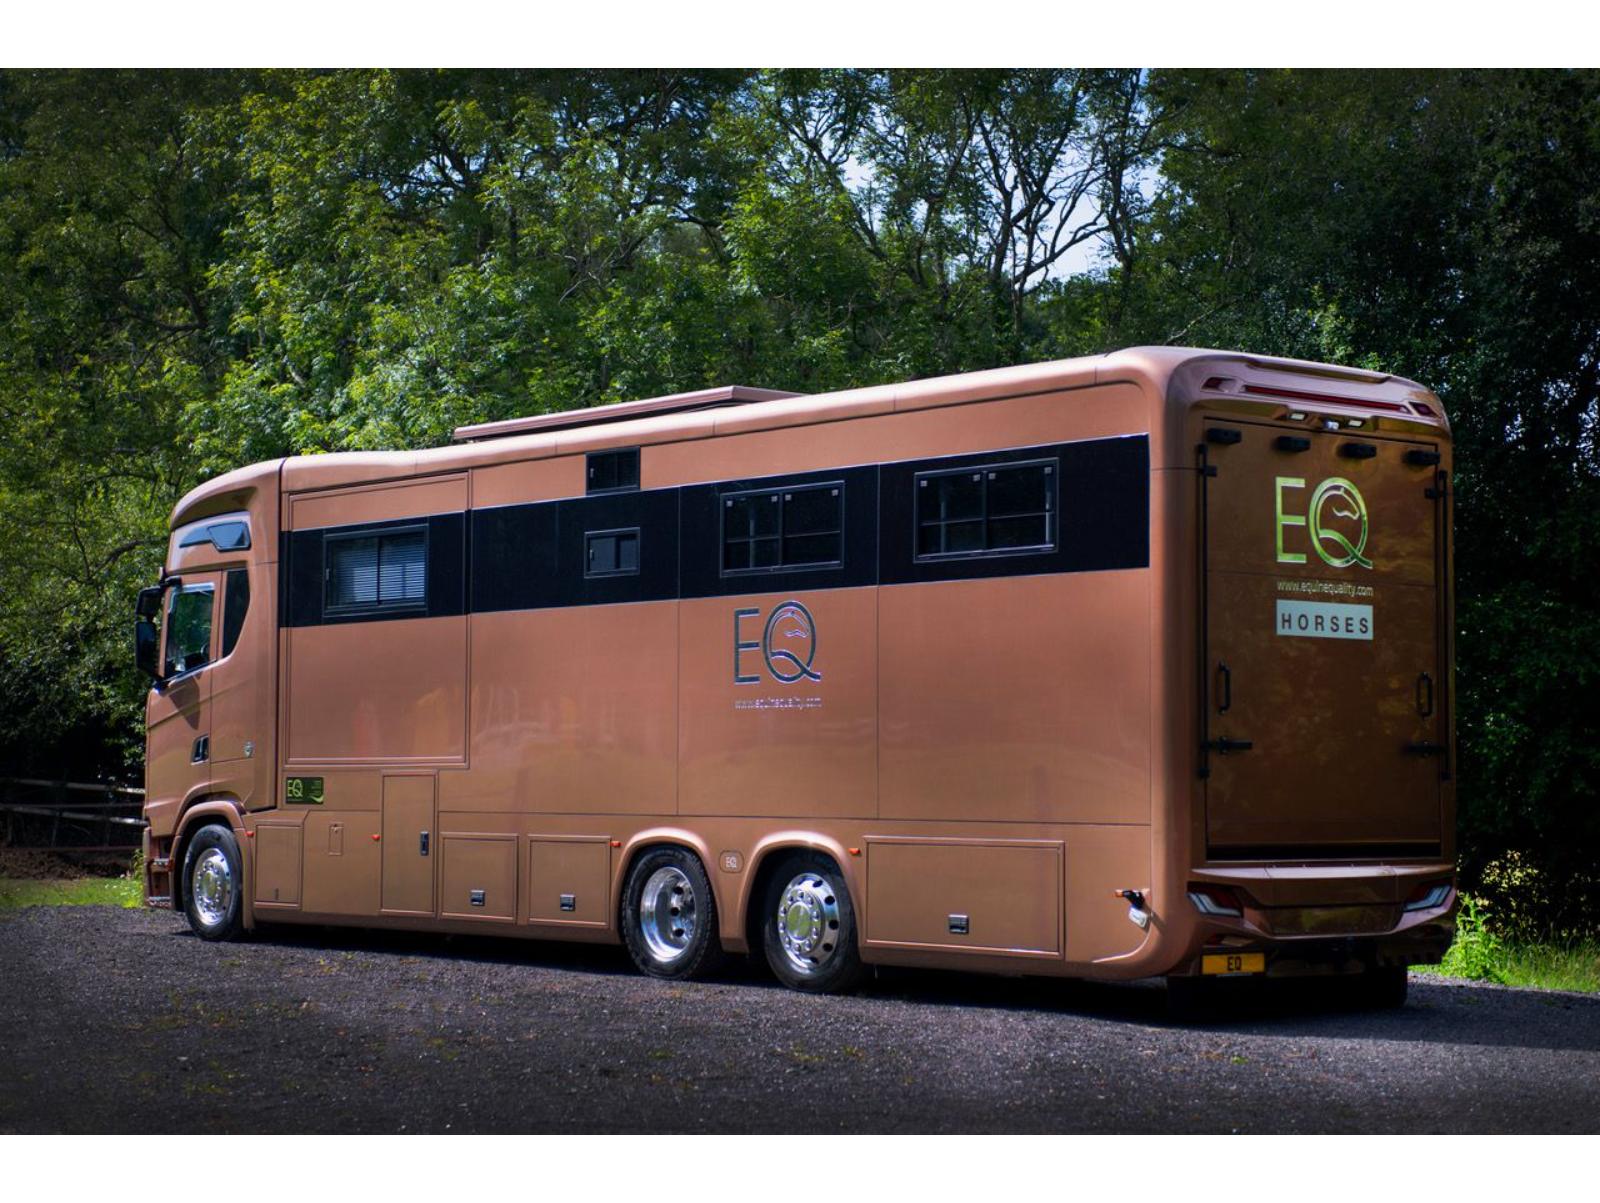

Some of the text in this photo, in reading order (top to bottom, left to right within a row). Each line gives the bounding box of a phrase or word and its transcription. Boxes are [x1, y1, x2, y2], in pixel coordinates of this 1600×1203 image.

[1275, 476, 1374, 569] EQ
[1276, 580, 1374, 597] www.equinequality.com
[734, 599, 821, 684] EQ
[1281, 612, 1369, 634] HORSES
